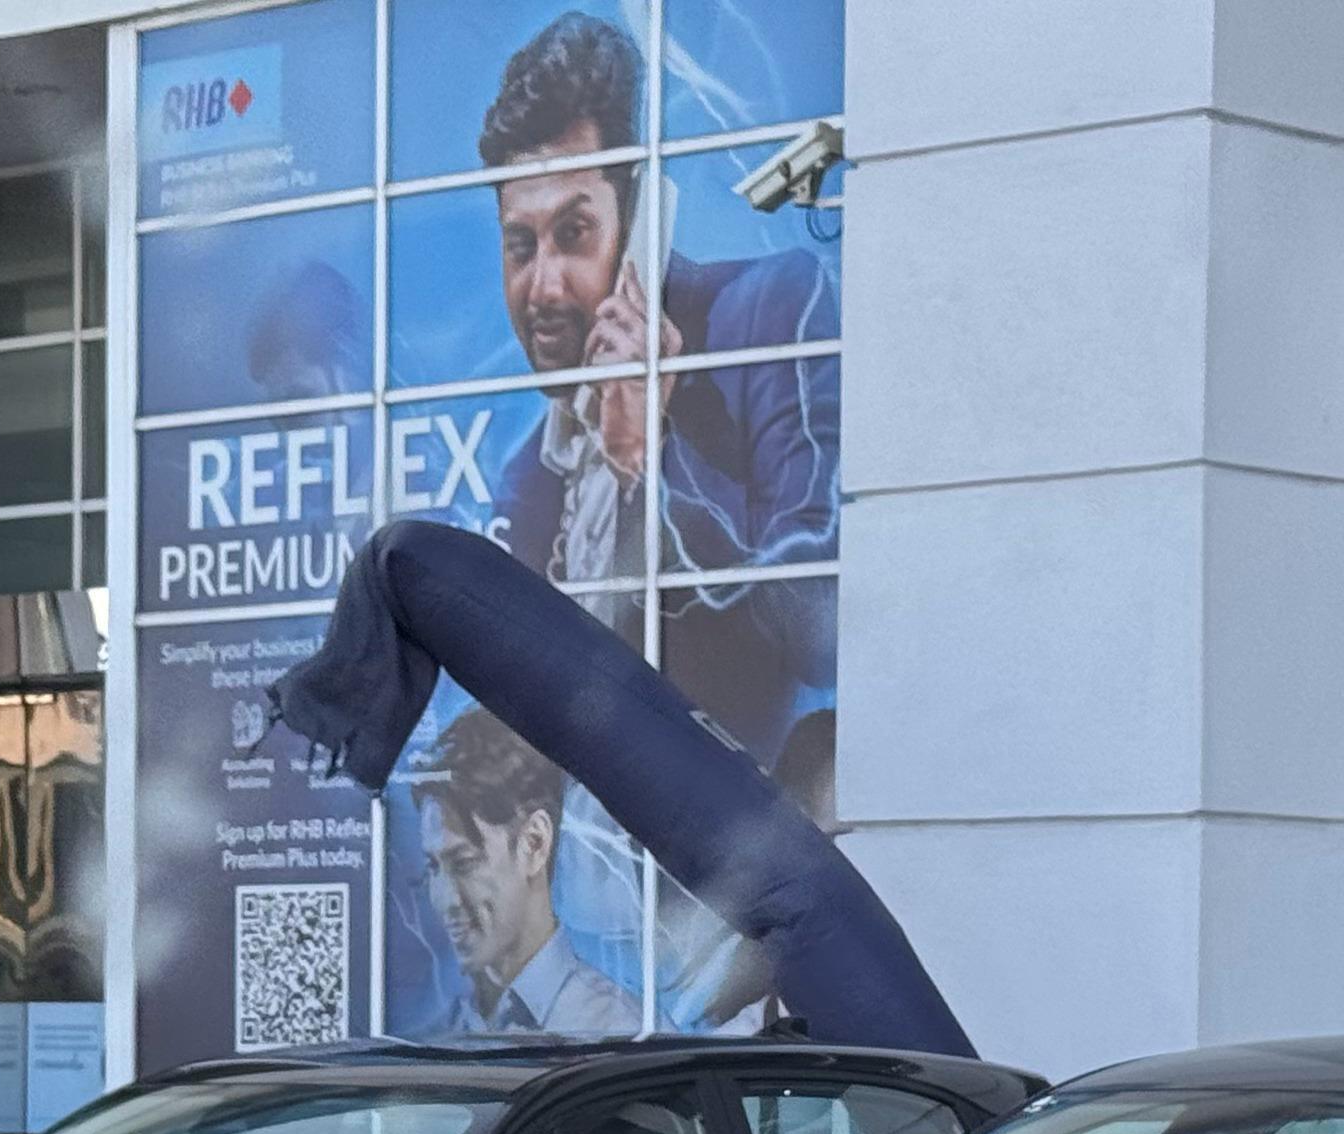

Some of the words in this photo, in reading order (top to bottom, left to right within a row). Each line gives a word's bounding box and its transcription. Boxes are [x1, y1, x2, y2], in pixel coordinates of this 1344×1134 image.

[161, 77, 227, 134] RHB
[188, 410, 493, 530] REFLEX
[160, 641, 216, 665] Simplify
[219, 643, 251, 663] your
[253, 638, 314, 658] business
[216, 821, 244, 847] Sign
[247, 825, 264, 845] up
[267, 820, 288, 839] for
[289, 819, 323, 839] RHB
[222, 848, 285, 871] Premium
[288, 847, 319, 868] Plus
